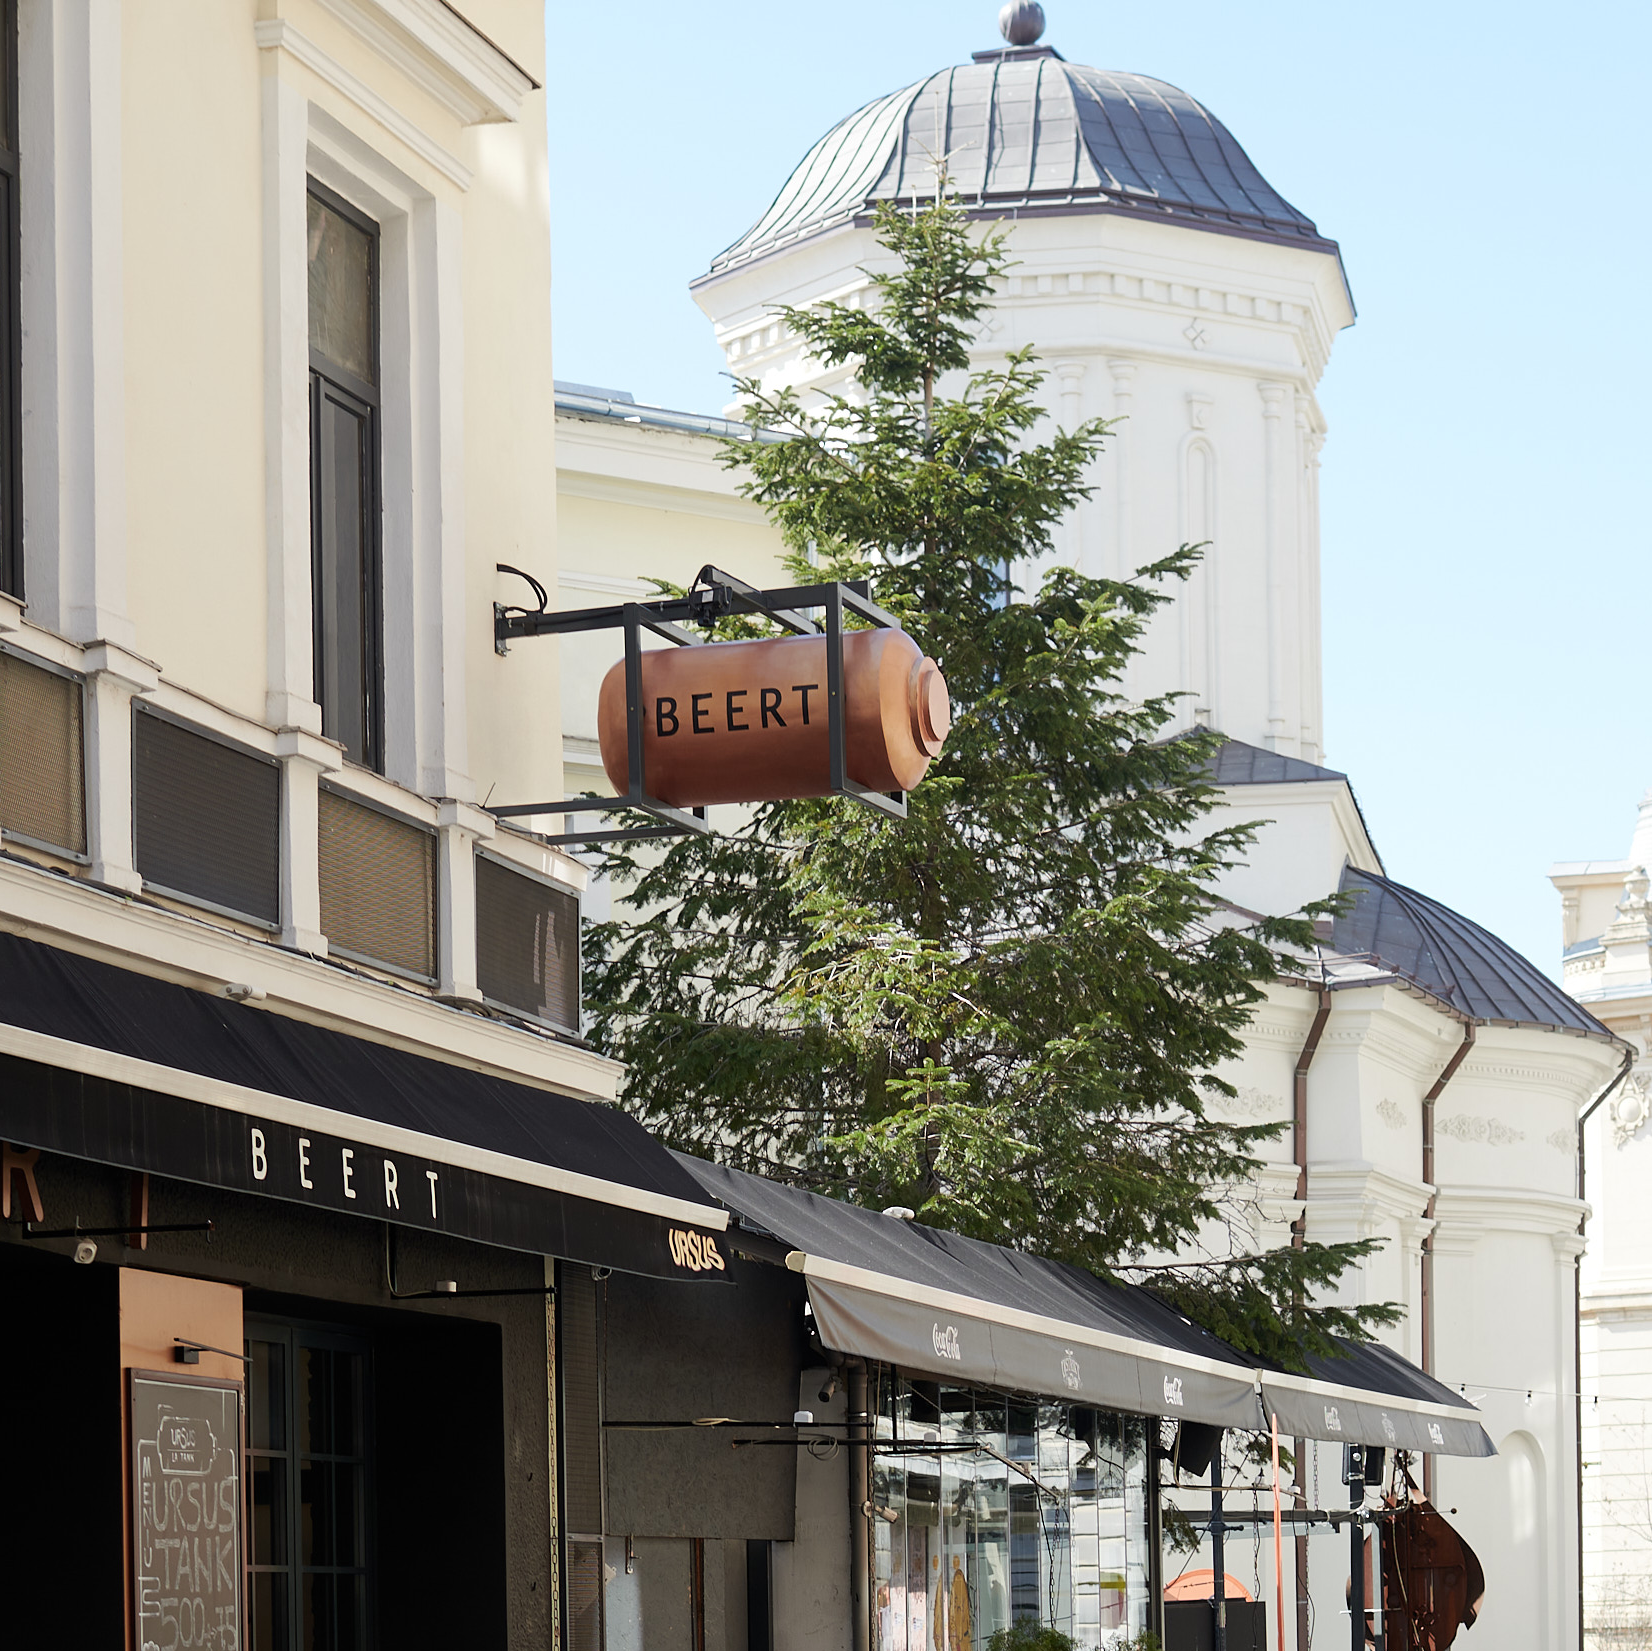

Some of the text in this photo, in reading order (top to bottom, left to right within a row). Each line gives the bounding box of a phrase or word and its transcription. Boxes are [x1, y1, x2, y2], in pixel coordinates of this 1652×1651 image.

[656, 684, 819, 737] BEERT
[251, 1127, 438, 1219] BEERT
[668, 1228, 726, 1271] URSUS
[171, 1427, 196, 1448] URSUS
[153, 1478, 234, 1532] URSUS
[155, 1535, 233, 1594] TANK
